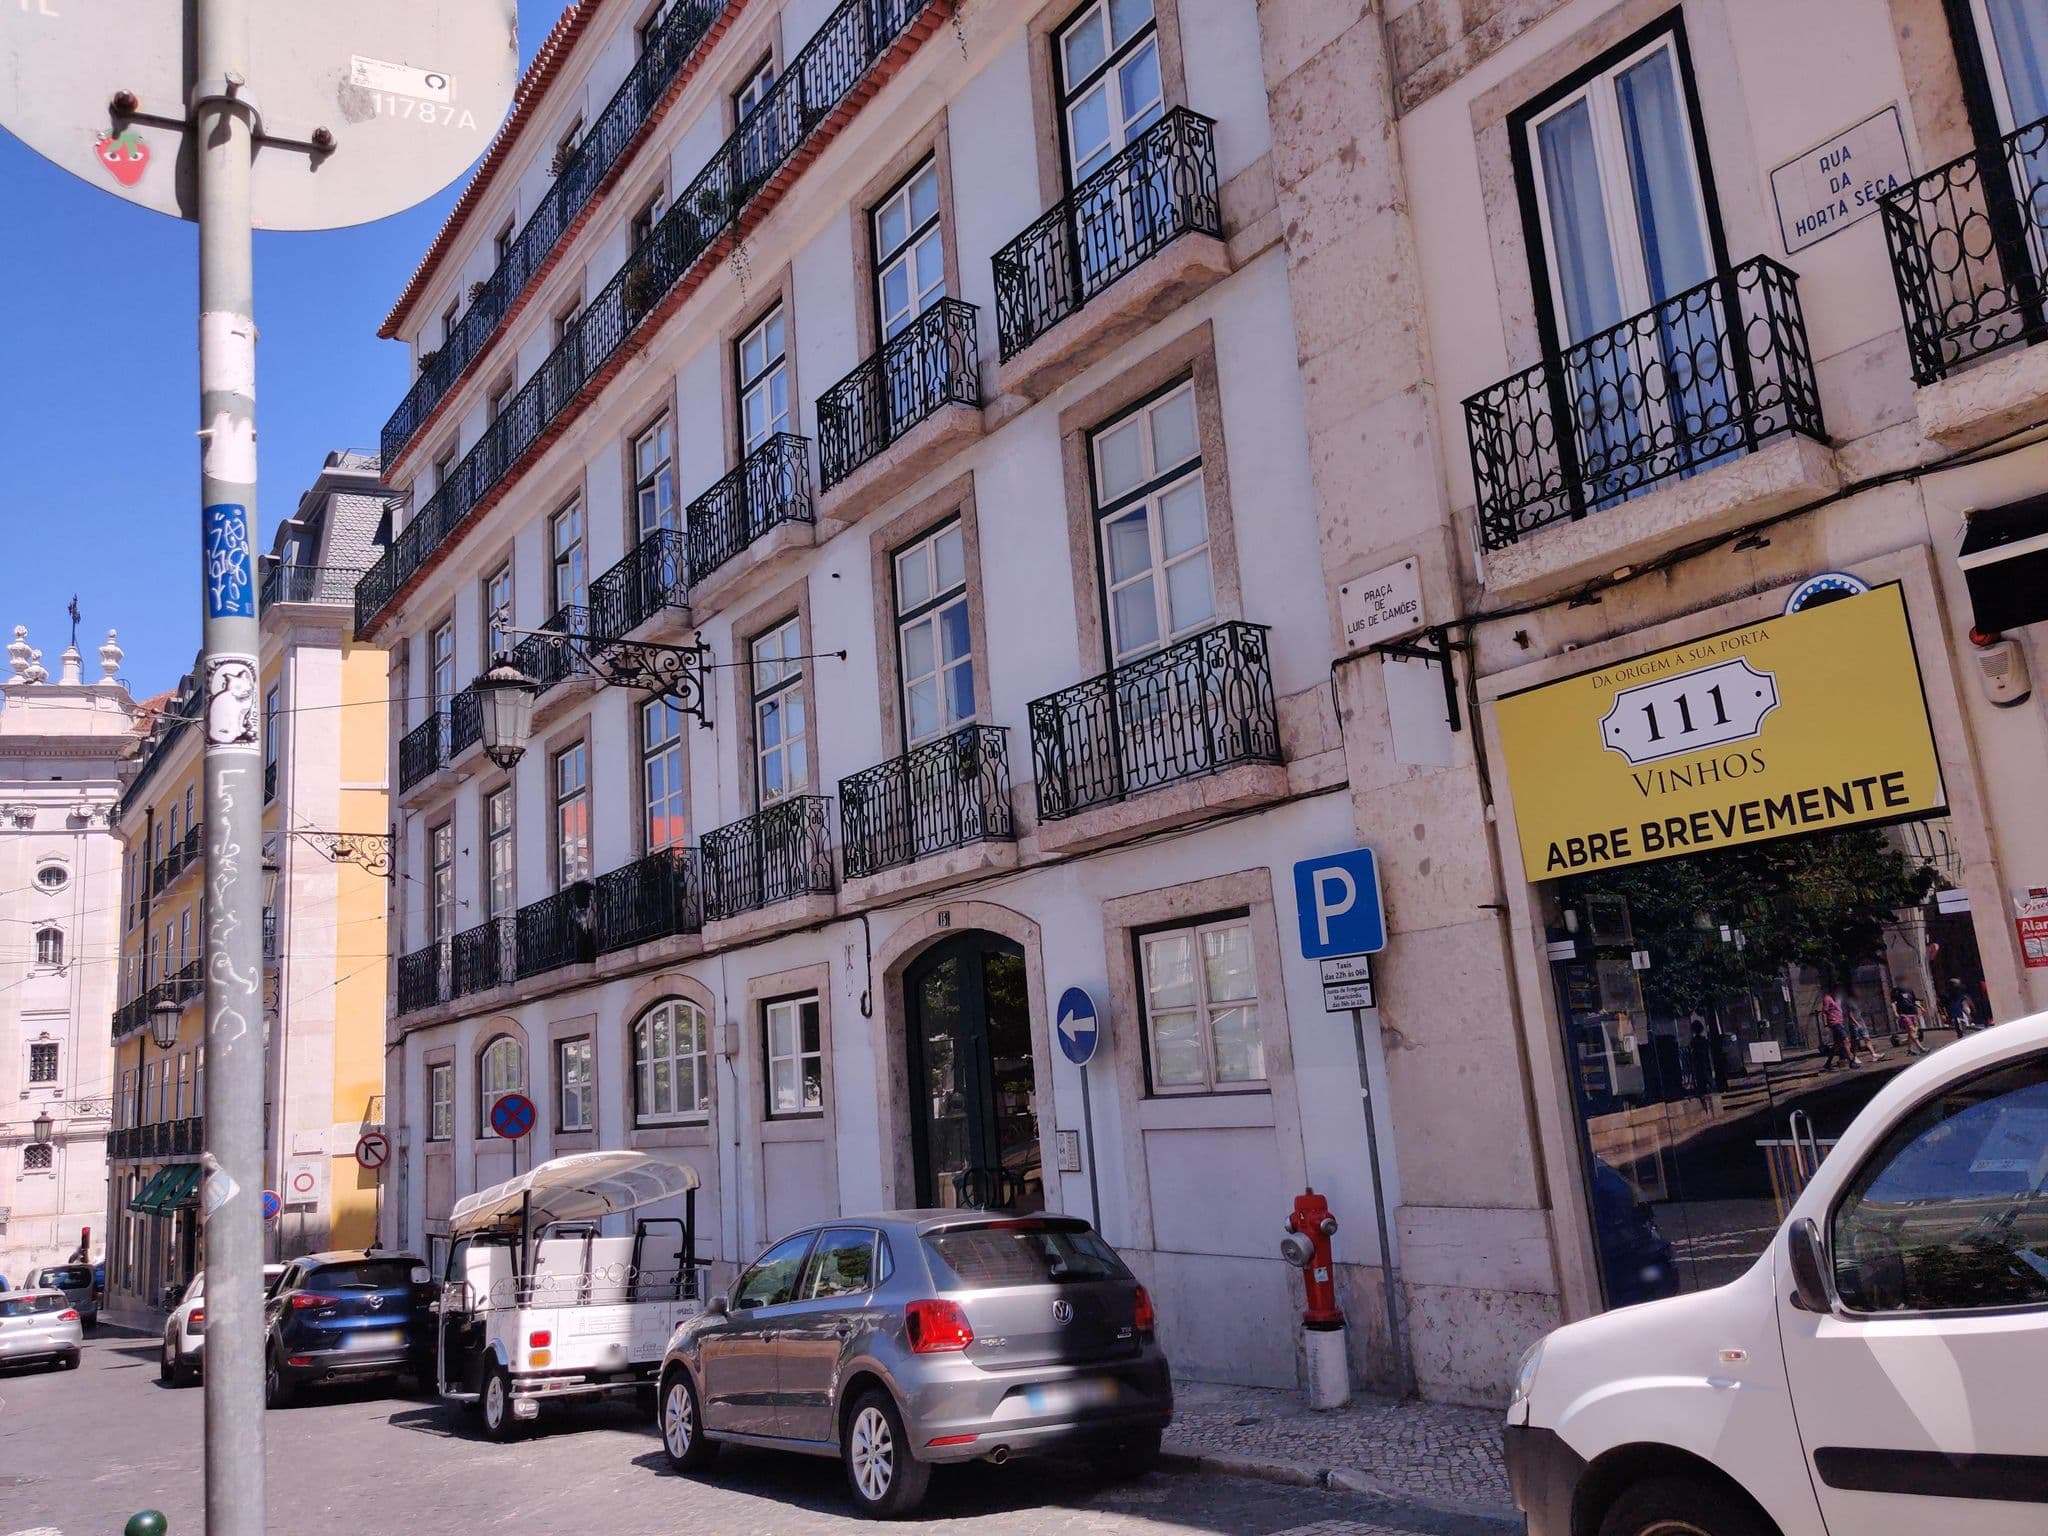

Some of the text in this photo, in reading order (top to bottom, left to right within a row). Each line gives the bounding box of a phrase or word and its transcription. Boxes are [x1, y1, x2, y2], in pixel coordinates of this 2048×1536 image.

[373, 93, 478, 131] 11787A
[1819, 145, 1852, 174] RUA
[1829, 172, 1852, 194] DA
[1795, 199, 1849, 237] HORTA
[1367, 613, 1379, 627] DE
[1374, 598, 1386, 612] DE
[1591, 629, 1771, 690] DA ORIGEM À SUA PORTA
[1640, 683, 1732, 743] 111
[1630, 748, 1767, 798] VINHOS
[1545, 770, 1910, 872] ABRE BREVEMENTE
[1312, 866, 1357, 946] P
[1324, 968, 1367, 981] das 22h às 06h
[1335, 960, 1353, 969] Taxis
